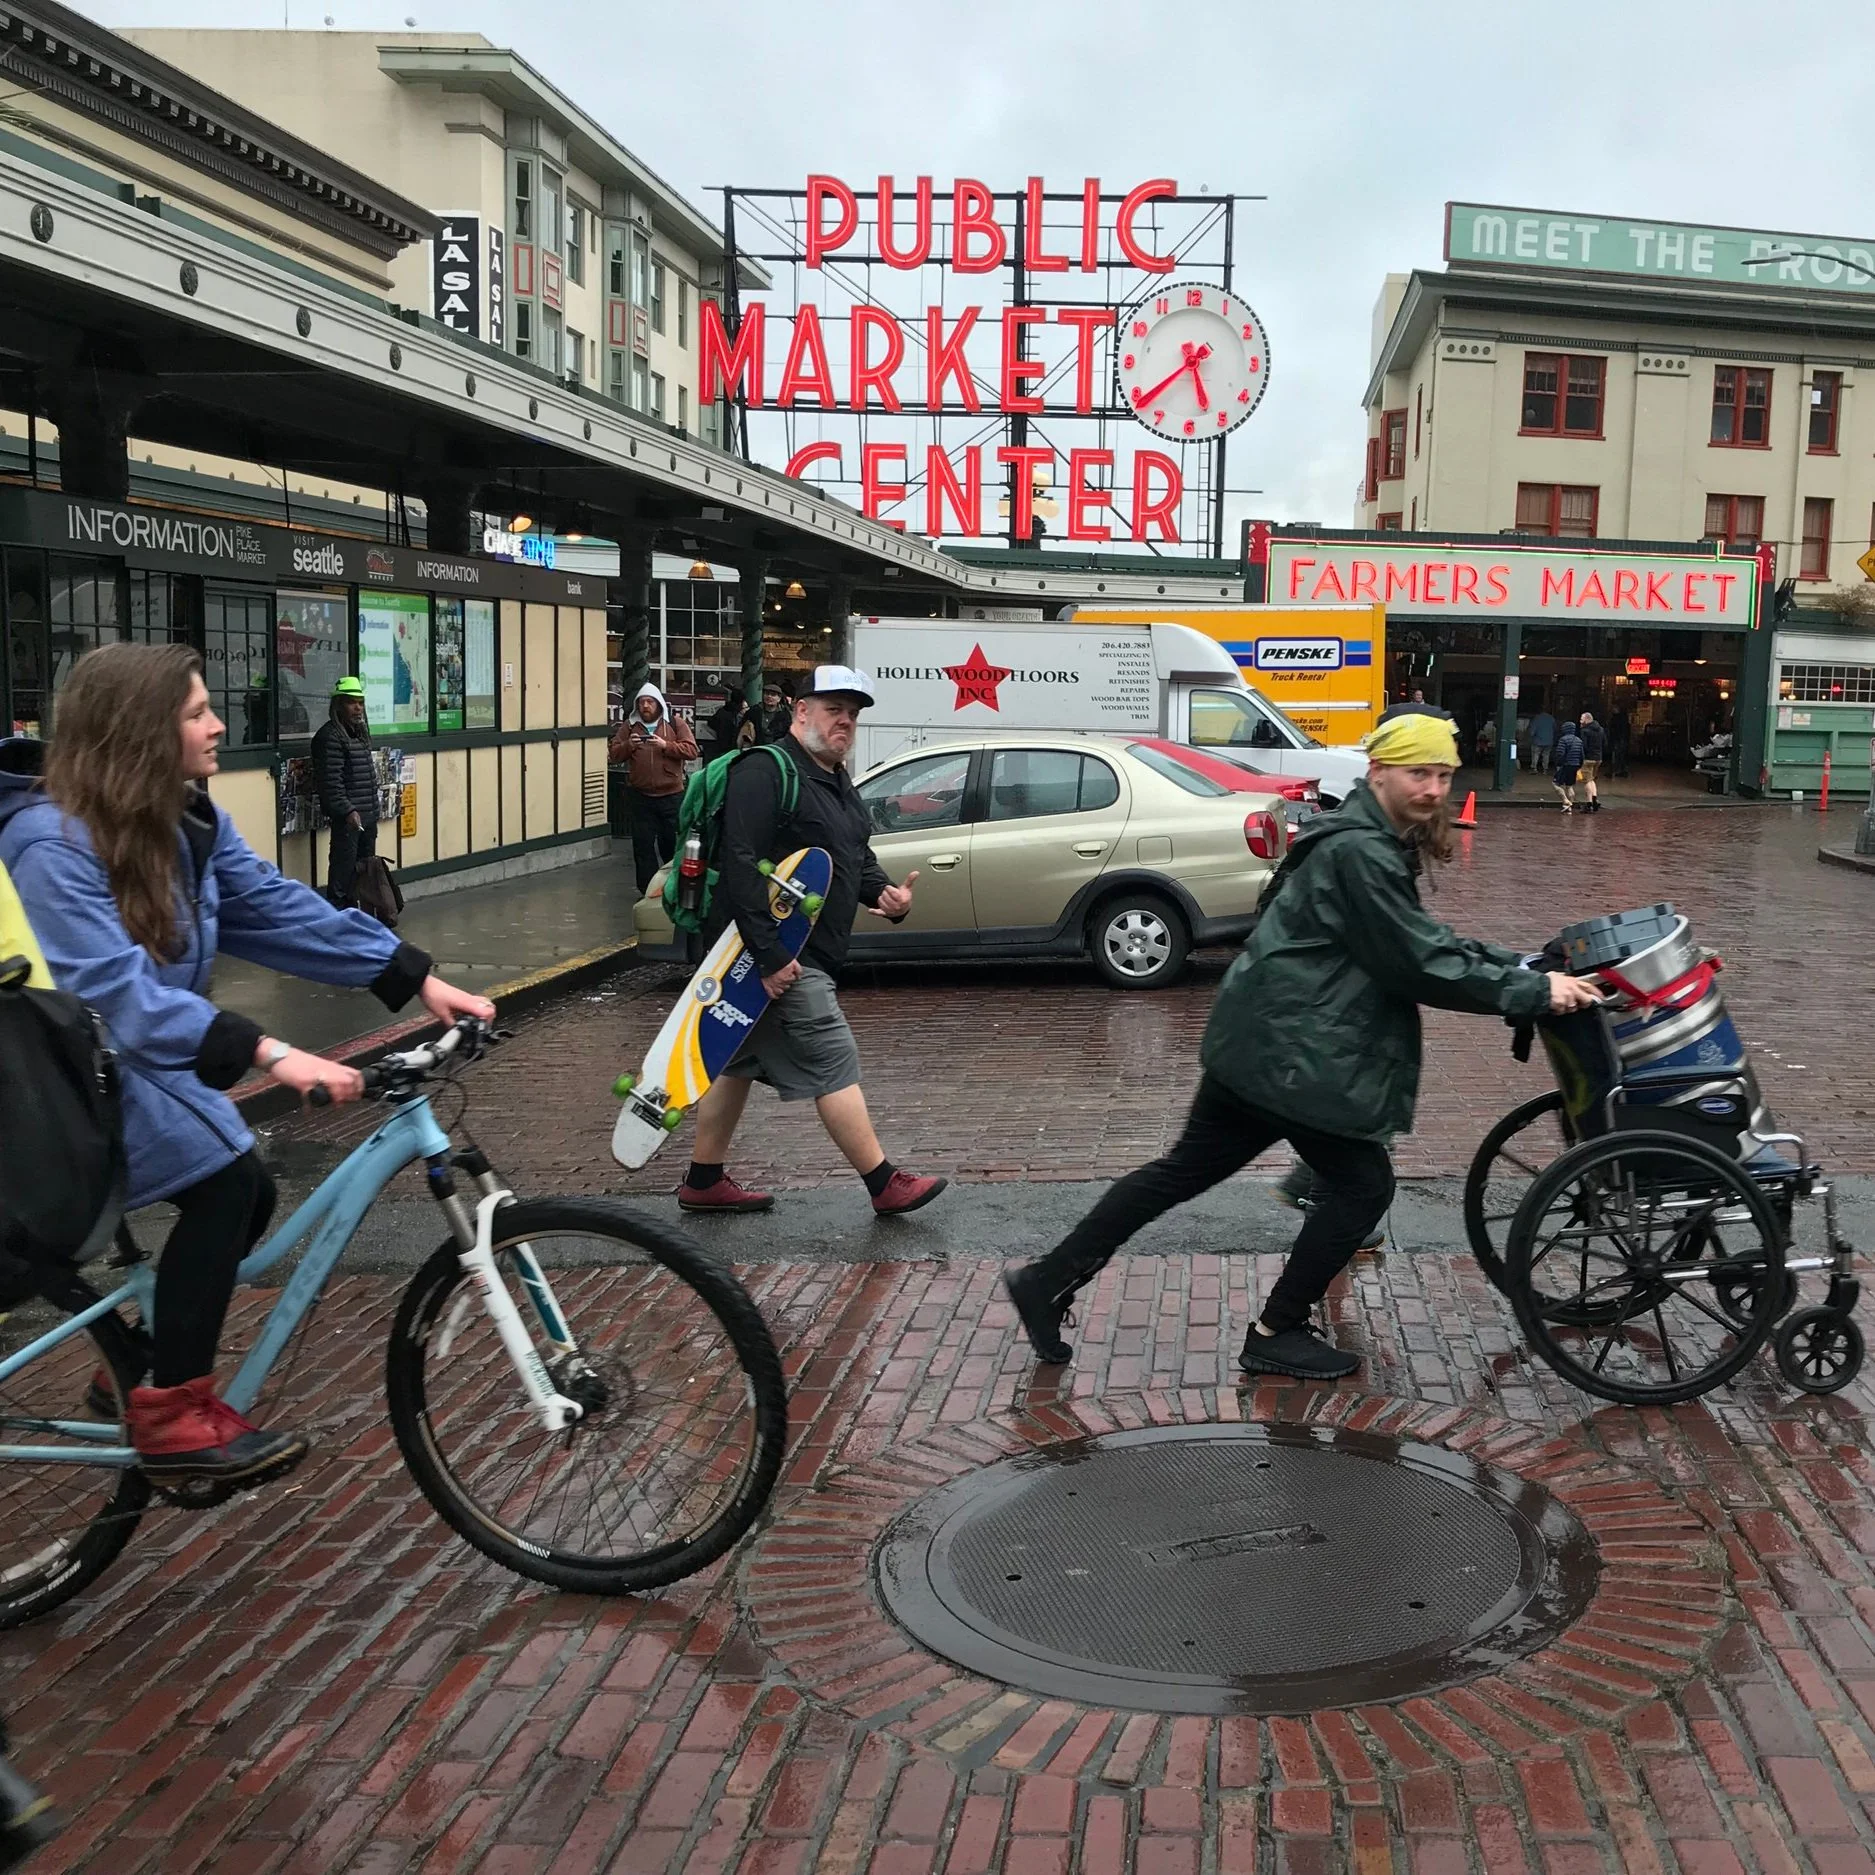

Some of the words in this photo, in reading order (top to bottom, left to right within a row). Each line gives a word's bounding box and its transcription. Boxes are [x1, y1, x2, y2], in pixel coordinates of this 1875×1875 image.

[806, 174, 1178, 274] PUBLIC
[1471, 214, 1600, 263] MEET
[1629, 228, 1715, 274] THE
[1157, 298, 1168, 314] 11
[1187, 290, 1202, 306] 12
[1223, 299, 1228, 316] 1
[1133, 322, 1147, 337] 10
[1242, 323, 1252, 340] 2
[699, 299, 1117, 415] MARKET
[1124, 354, 1134, 369] 9
[1249, 356, 1259, 373] 3
[1131, 387, 1142, 402] 8
[1237, 388, 1249, 404] 4
[1154, 410, 1165, 425] 7
[1217, 411, 1228, 427] 5
[1184, 420, 1194, 435] 6
[67, 504, 234, 559] INFORMATION
[236, 525, 253, 539] PIKE
[236, 539, 261, 552] PLACE
[293, 535, 315, 547] VISIT
[484, 529, 523, 558] CHASE
[237, 551, 267, 565] MARKET
[293, 543, 344, 576] seattle
[417, 560, 479, 584] INFORMATION
[567, 580, 582, 595] bank
[1289, 558, 1510, 605] FARMERS
[1541, 566, 1737, 612] MARKET
[1262, 647, 1336, 660] PENSKE
[876, 666, 1006, 682] HOLLEYWOOD
[1010, 669, 1080, 684] FLOORS
[1270, 672, 1295, 681] Truck
[1296, 672, 1327, 681] Rental
[958, 687, 996, 700] INC.
[696, 977, 717, 1002] 9
